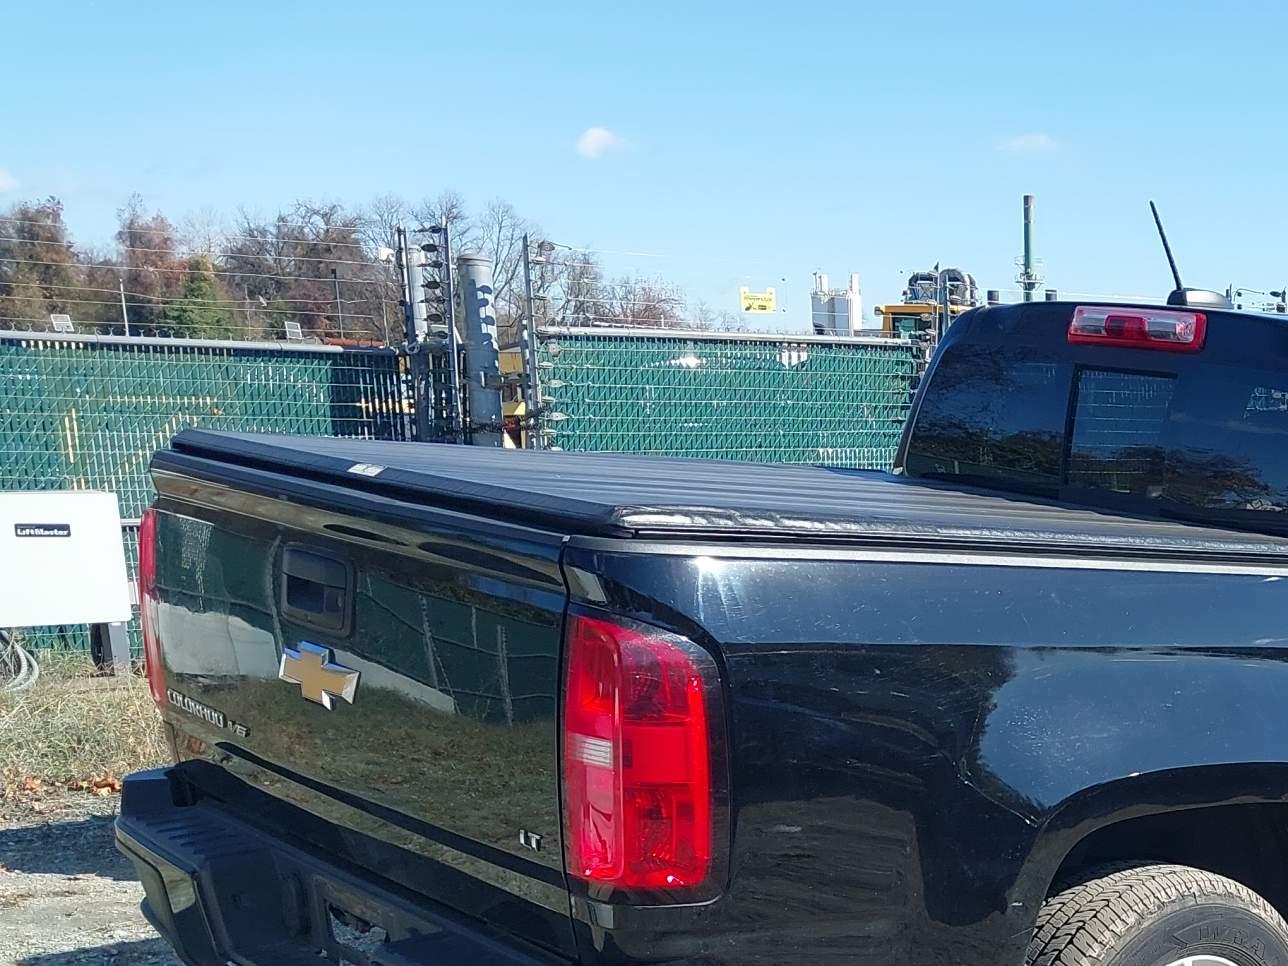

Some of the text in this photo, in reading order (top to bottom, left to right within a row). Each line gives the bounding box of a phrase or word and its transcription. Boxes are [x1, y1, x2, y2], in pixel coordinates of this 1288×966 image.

[16, 528, 69, 536] LiftMaster
[167, 687, 225, 729] COLORADO
[519, 829, 541, 852] LT
